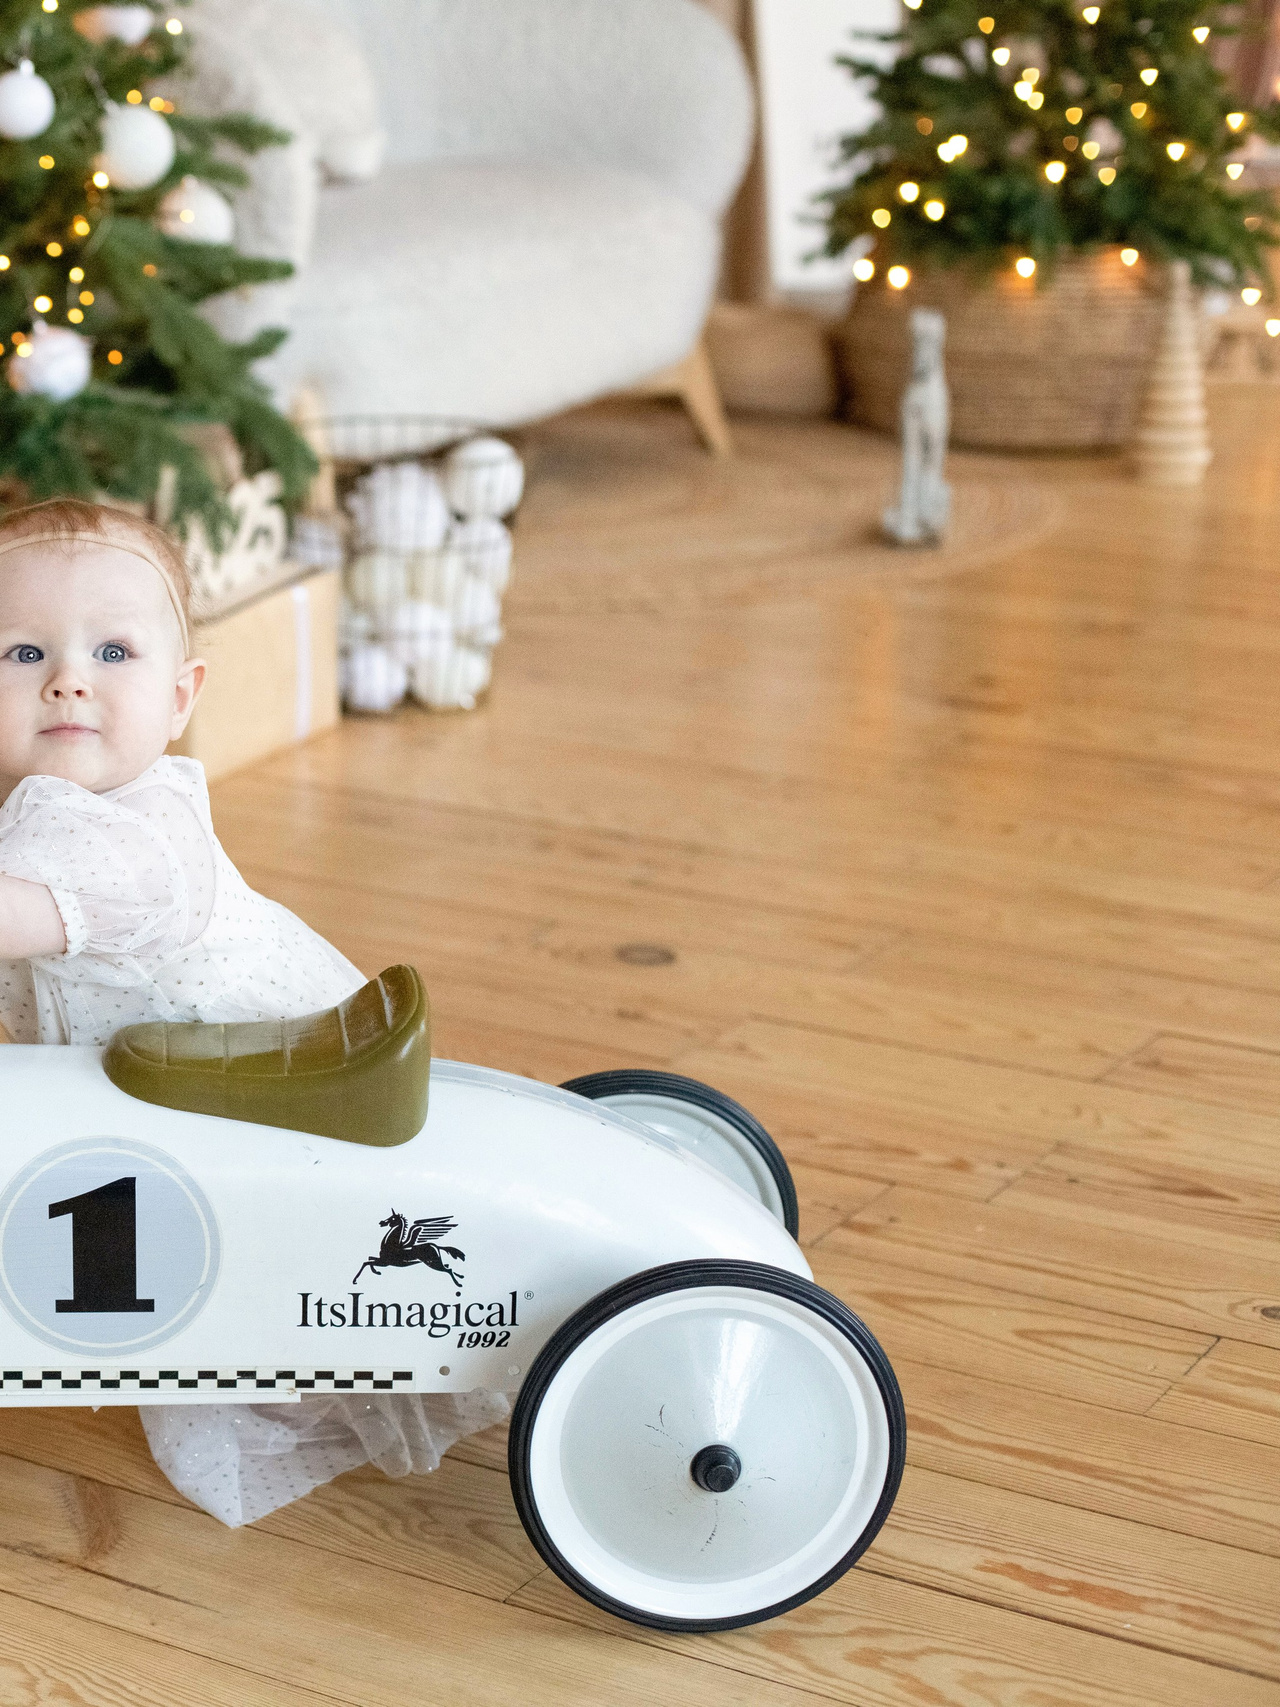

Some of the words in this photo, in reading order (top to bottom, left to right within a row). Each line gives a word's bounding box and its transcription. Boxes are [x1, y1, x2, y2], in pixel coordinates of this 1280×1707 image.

[47, 1176, 155, 1314] 1
[297, 1291, 519, 1338] ItsImagical
[456, 1330, 512, 1349] 1992
